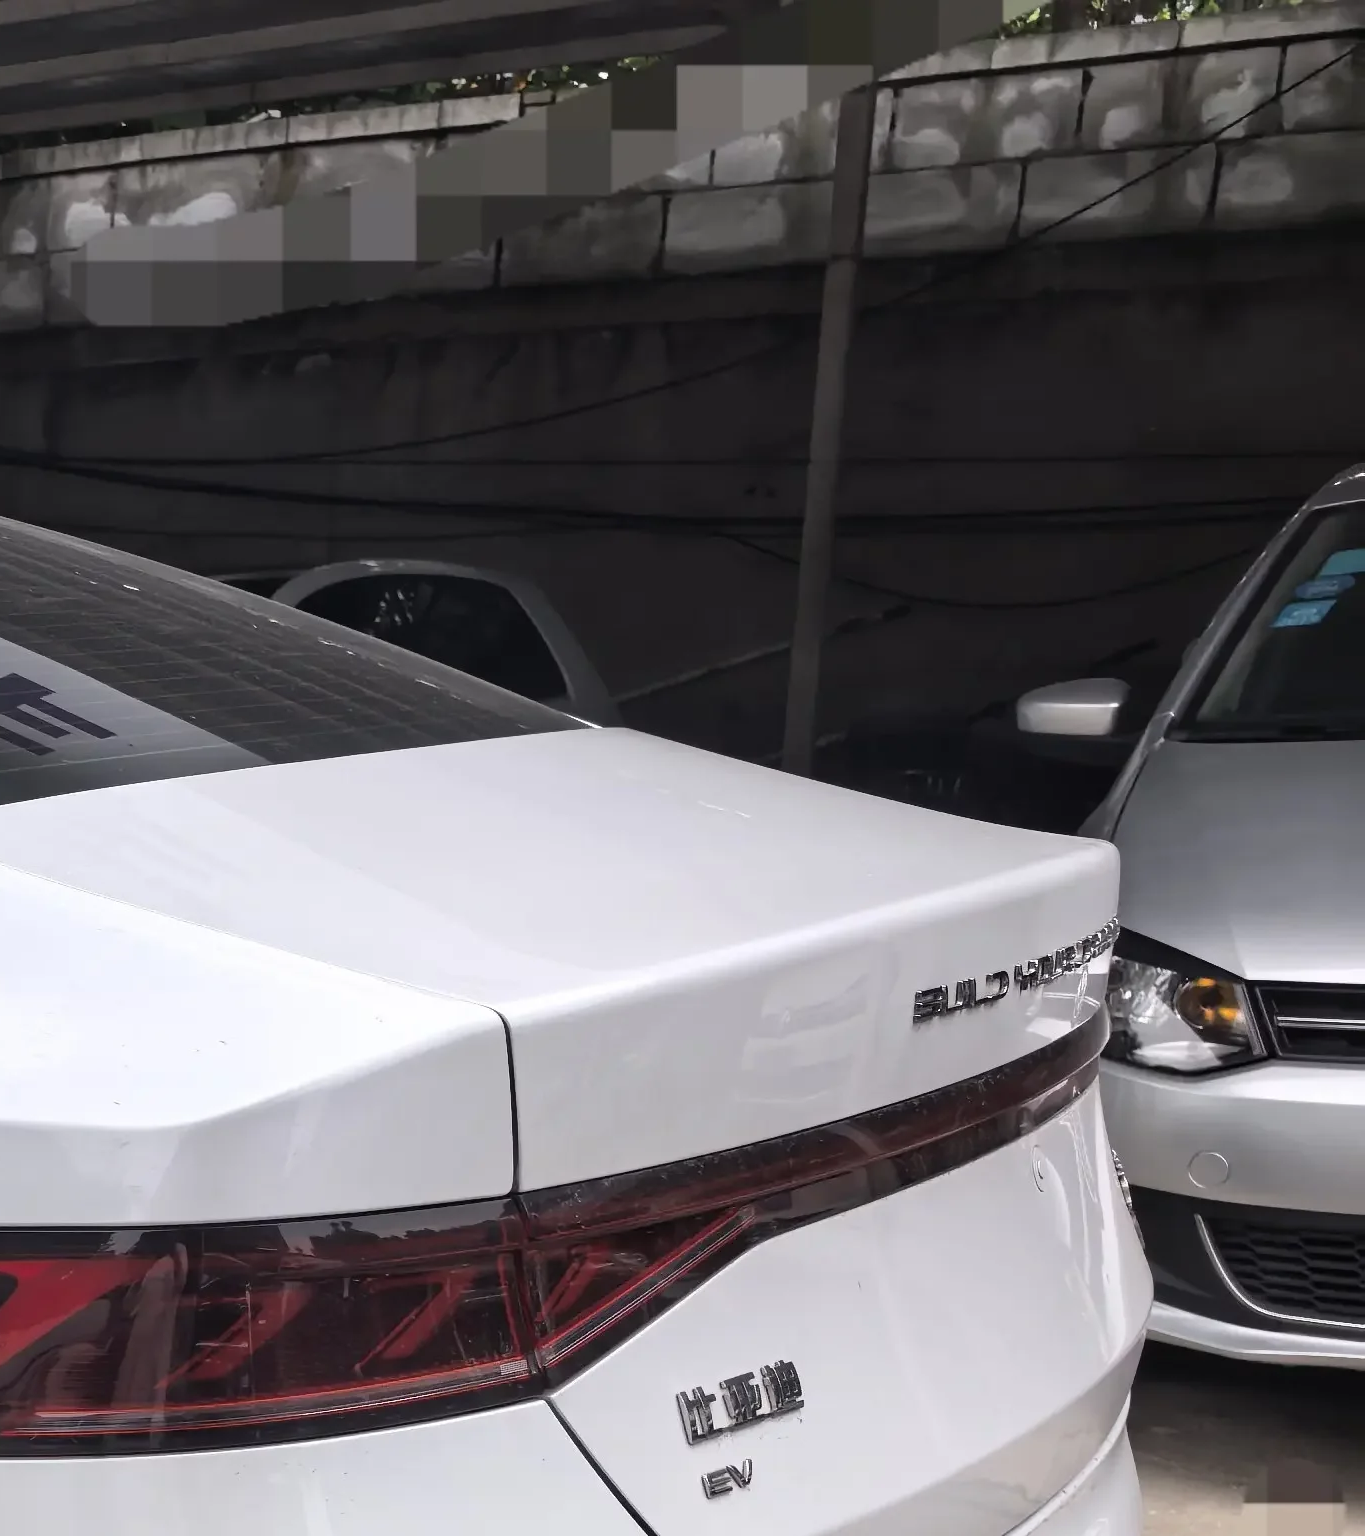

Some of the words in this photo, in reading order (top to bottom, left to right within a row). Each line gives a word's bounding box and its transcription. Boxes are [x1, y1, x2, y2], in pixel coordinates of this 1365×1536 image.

[676, 1359, 805, 1446] 比亚迪
[701, 1458, 754, 1500] EV
